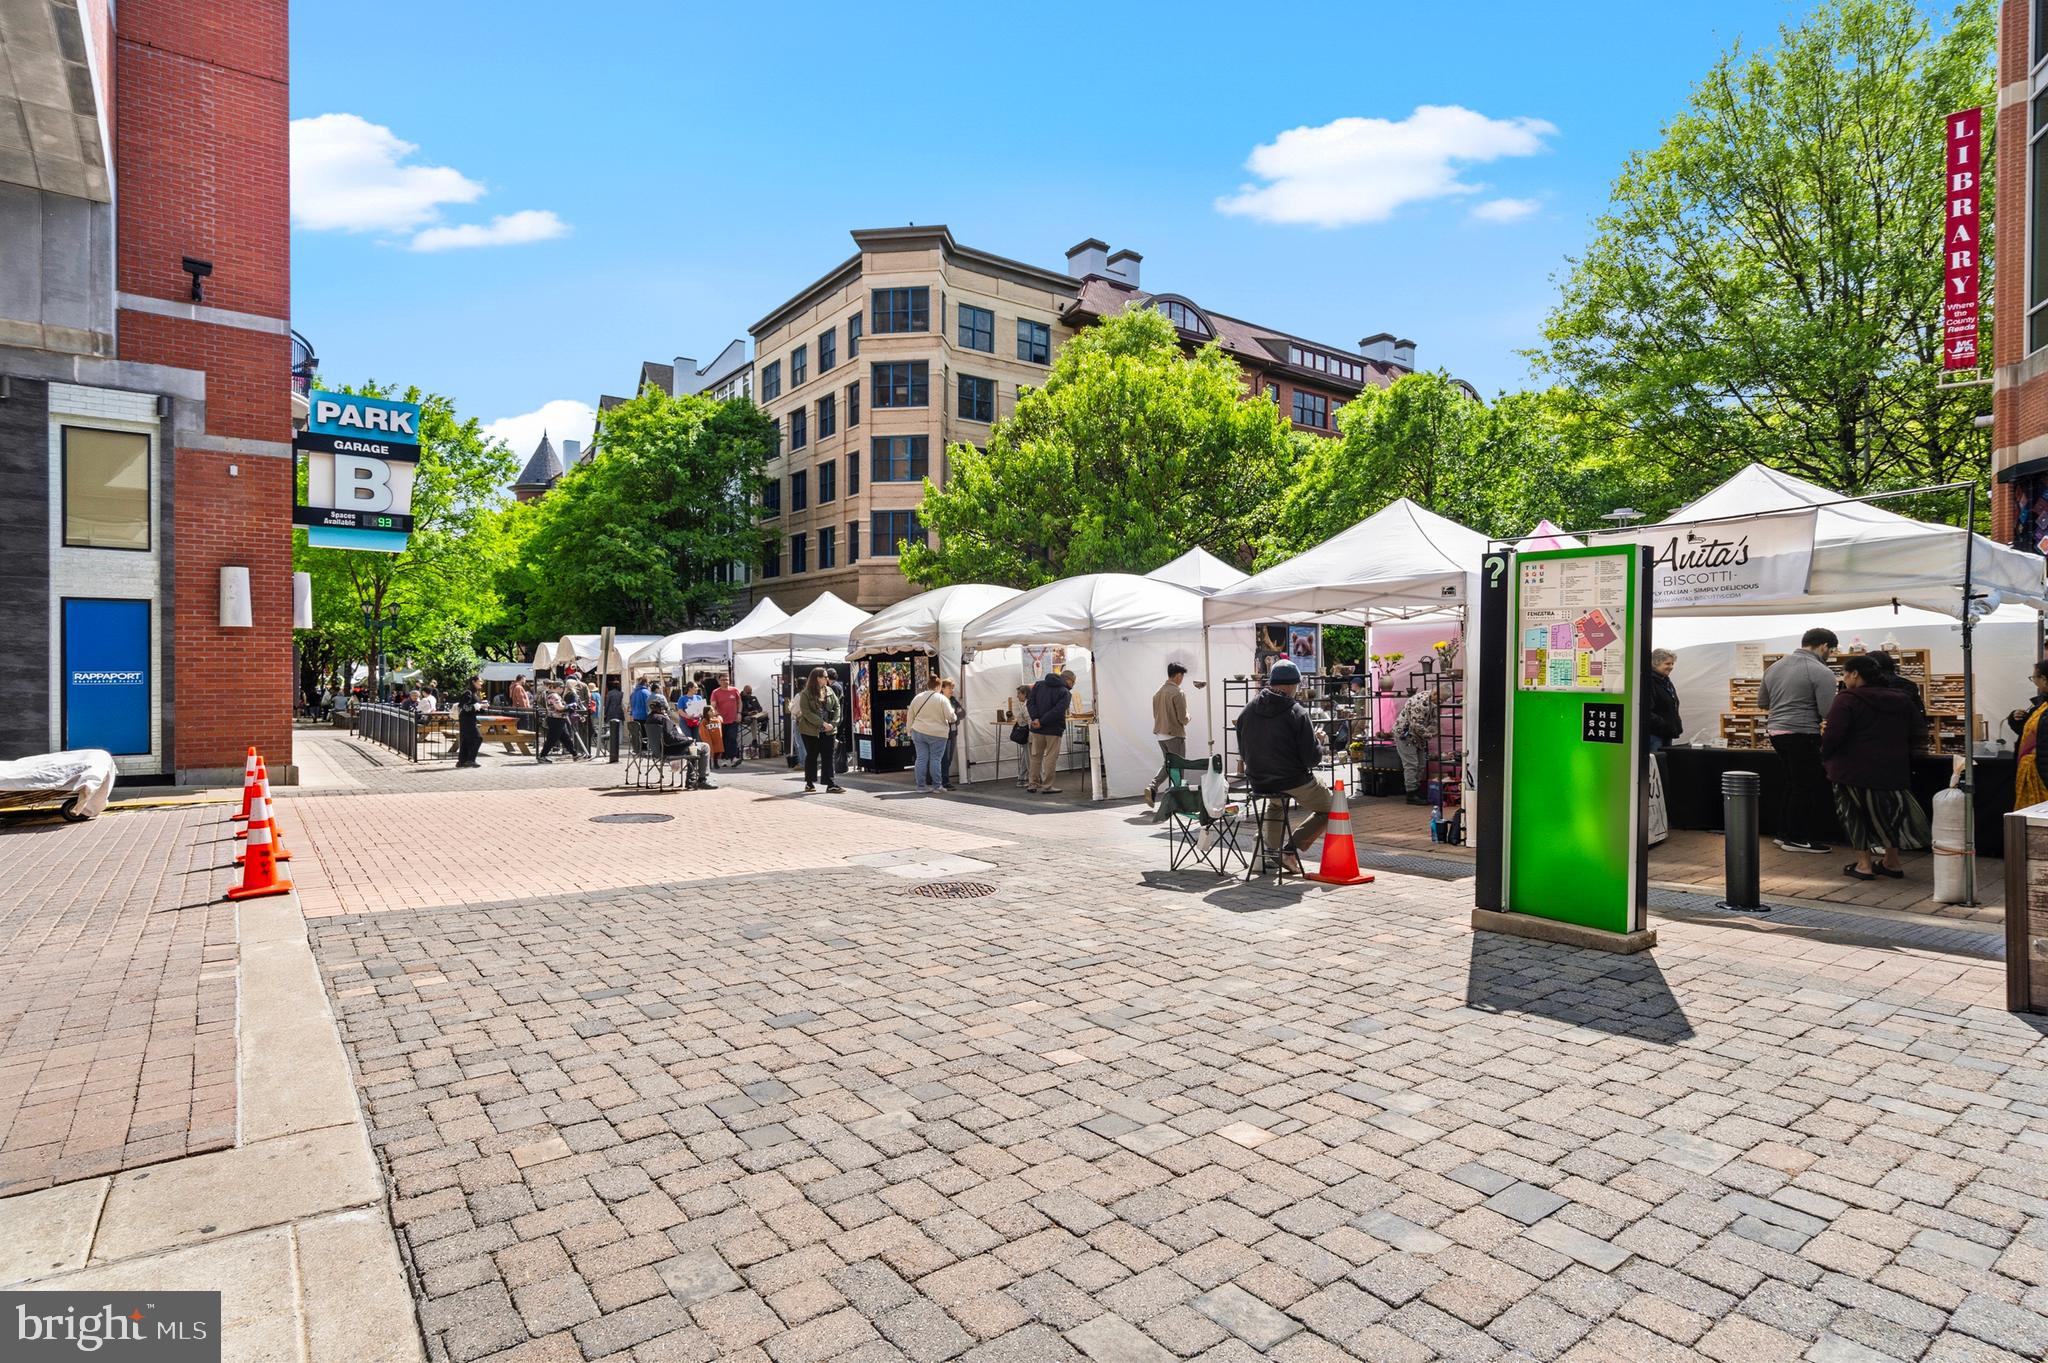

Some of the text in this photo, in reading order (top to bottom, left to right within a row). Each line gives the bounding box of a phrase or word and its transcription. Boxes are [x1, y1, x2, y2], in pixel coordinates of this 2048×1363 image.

[1950, 119, 1974, 295] LIBRARY
[1947, 302, 1975, 311] Where
[1946, 316, 1976, 326] County
[1947, 324, 1976, 333] Reads
[317, 400, 415, 435] PARK
[333, 440, 390, 455] GARAGE
[334, 453, 394, 513] B
[330, 511, 357, 519] Spaces
[323, 517, 356, 527] Available
[377, 517, 393, 527] 93
[1653, 535, 1749, 572] Anita's
[1663, 570, 1732, 587] BISCOTTI
[1693, 584, 1719, 593] SIMPLY
[1720, 582, 1760, 592] DELICIOUS
[74, 672, 142, 680] RAPPAPORT
[1588, 710, 1617, 719] THE
